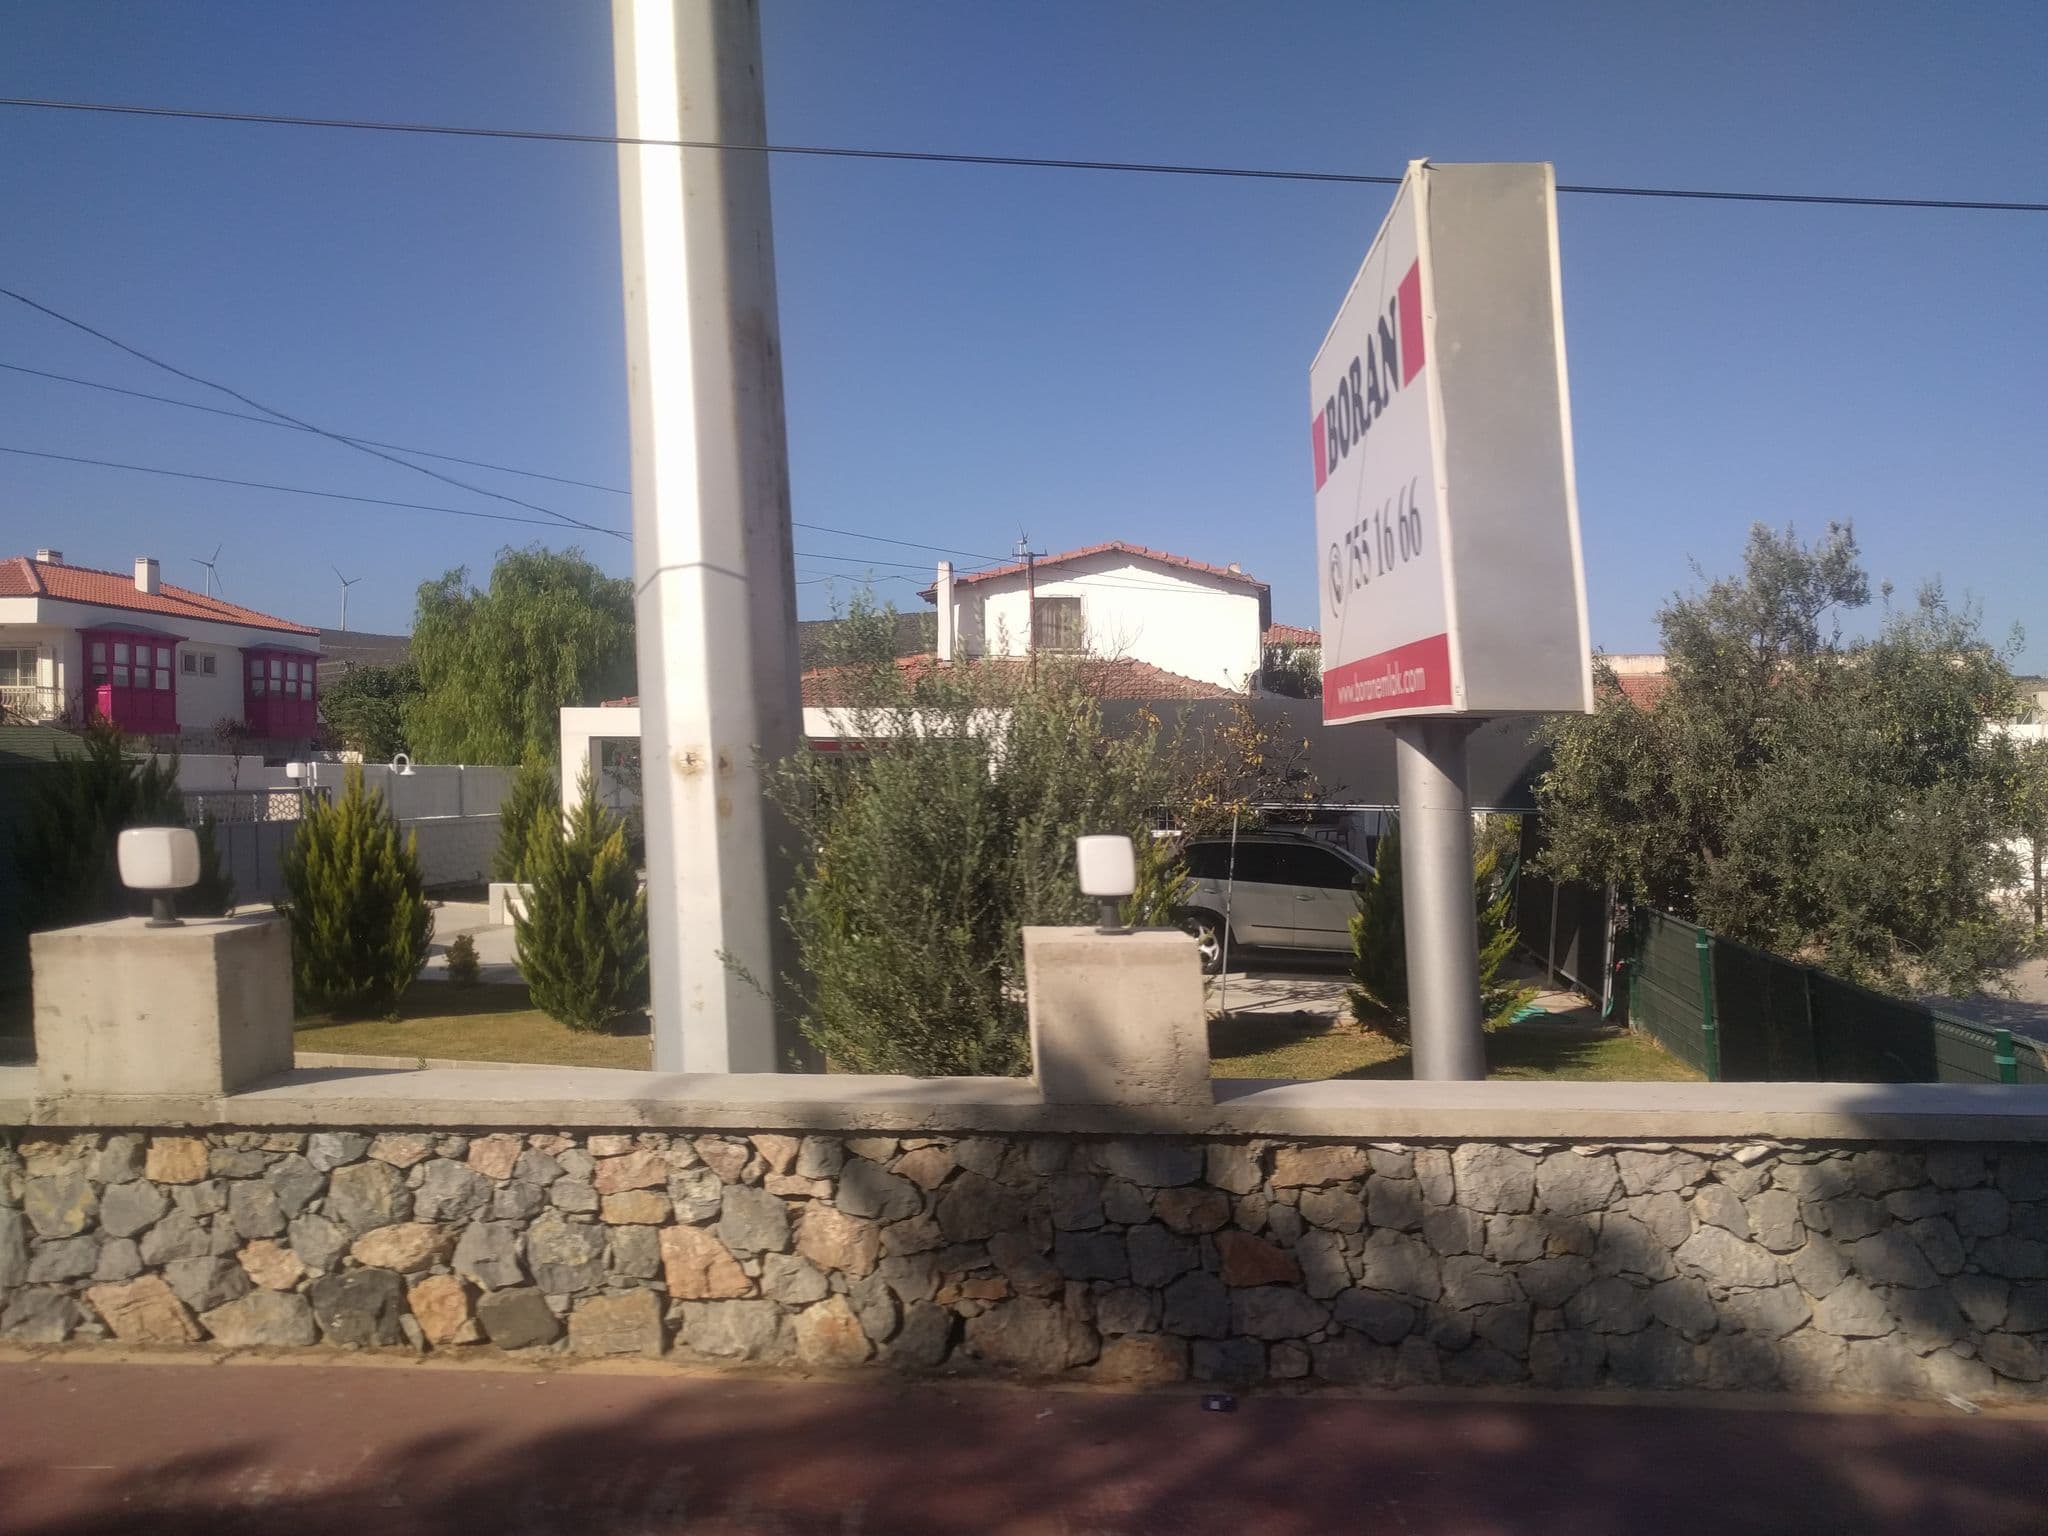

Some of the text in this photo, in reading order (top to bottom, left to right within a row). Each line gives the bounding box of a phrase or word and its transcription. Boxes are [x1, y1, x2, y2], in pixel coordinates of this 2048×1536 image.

[1326, 295, 1399, 475] BORAN
[1374, 497, 1394, 577] 16
[1399, 475, 1422, 562] 66
